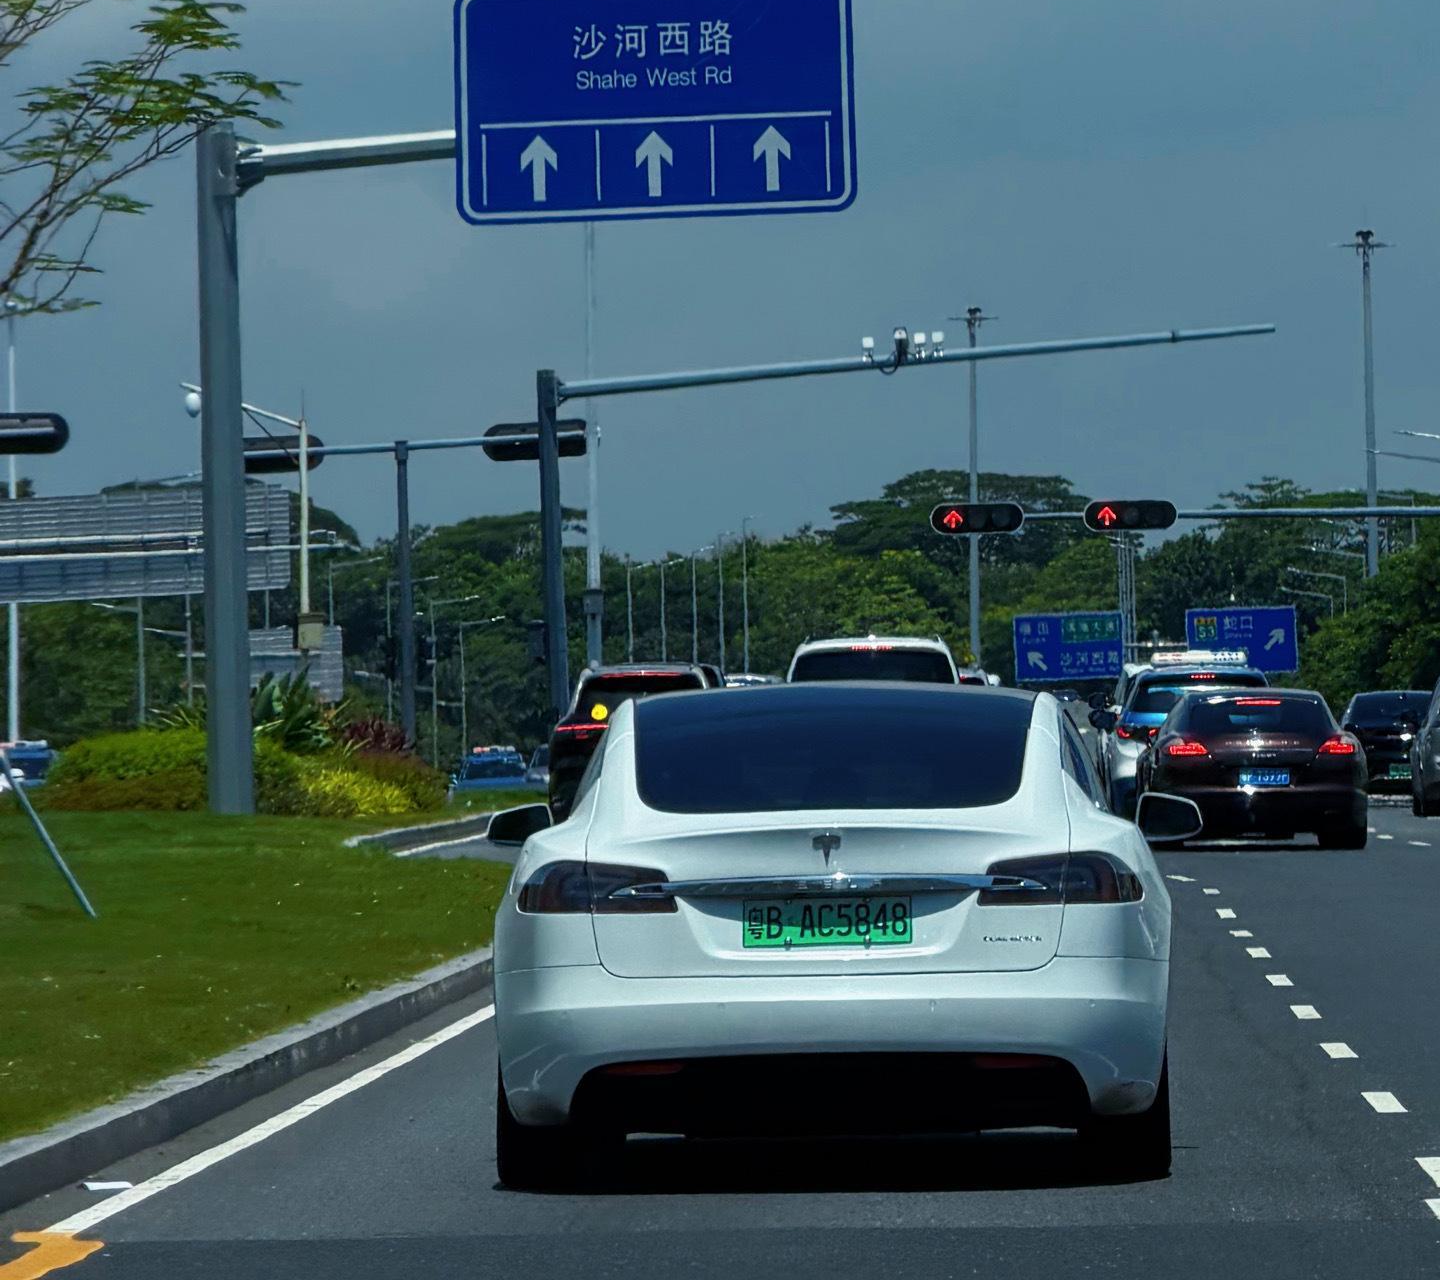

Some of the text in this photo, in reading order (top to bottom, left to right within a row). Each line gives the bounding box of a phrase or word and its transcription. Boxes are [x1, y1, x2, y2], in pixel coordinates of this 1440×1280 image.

[572, 19, 733, 60] 沙河西路
[576, 65, 732, 90] Shahe West Rd
[800, 902, 908, 938] AC5848
